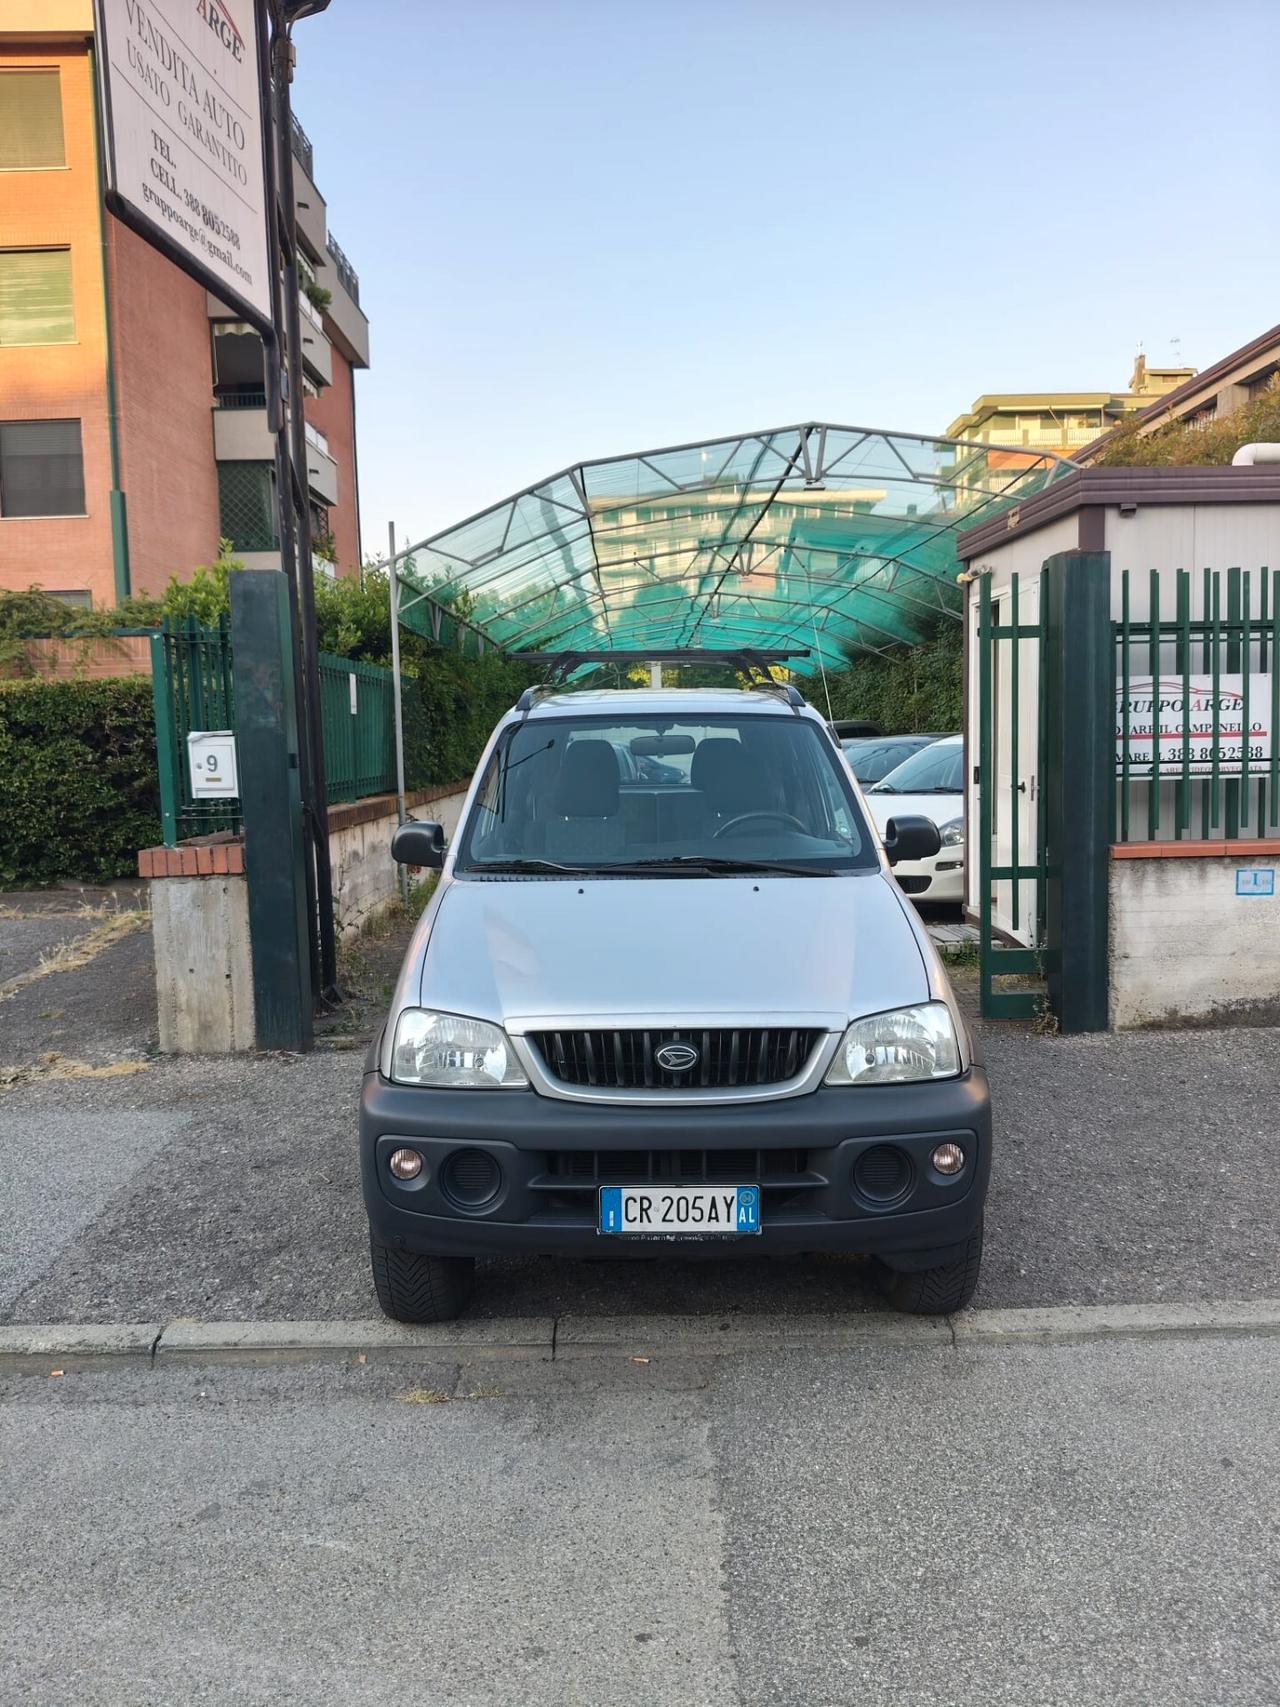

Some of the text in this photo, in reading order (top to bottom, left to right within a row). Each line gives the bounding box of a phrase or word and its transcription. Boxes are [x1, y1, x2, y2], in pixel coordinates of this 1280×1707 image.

[197, 0, 242, 64] ARGE
[126, 0, 245, 150] VENDITA AUTO
[126, 37, 247, 186] USATO GARANTITO
[151, 129, 176, 168] TEL.
[151, 158, 182, 201] CELL.
[184, 188, 200, 217] 388
[142, 183, 253, 286] gruppoarge@gmail.com
[206, 755, 218, 773] 9
[739, 1207, 755, 1223] AL
